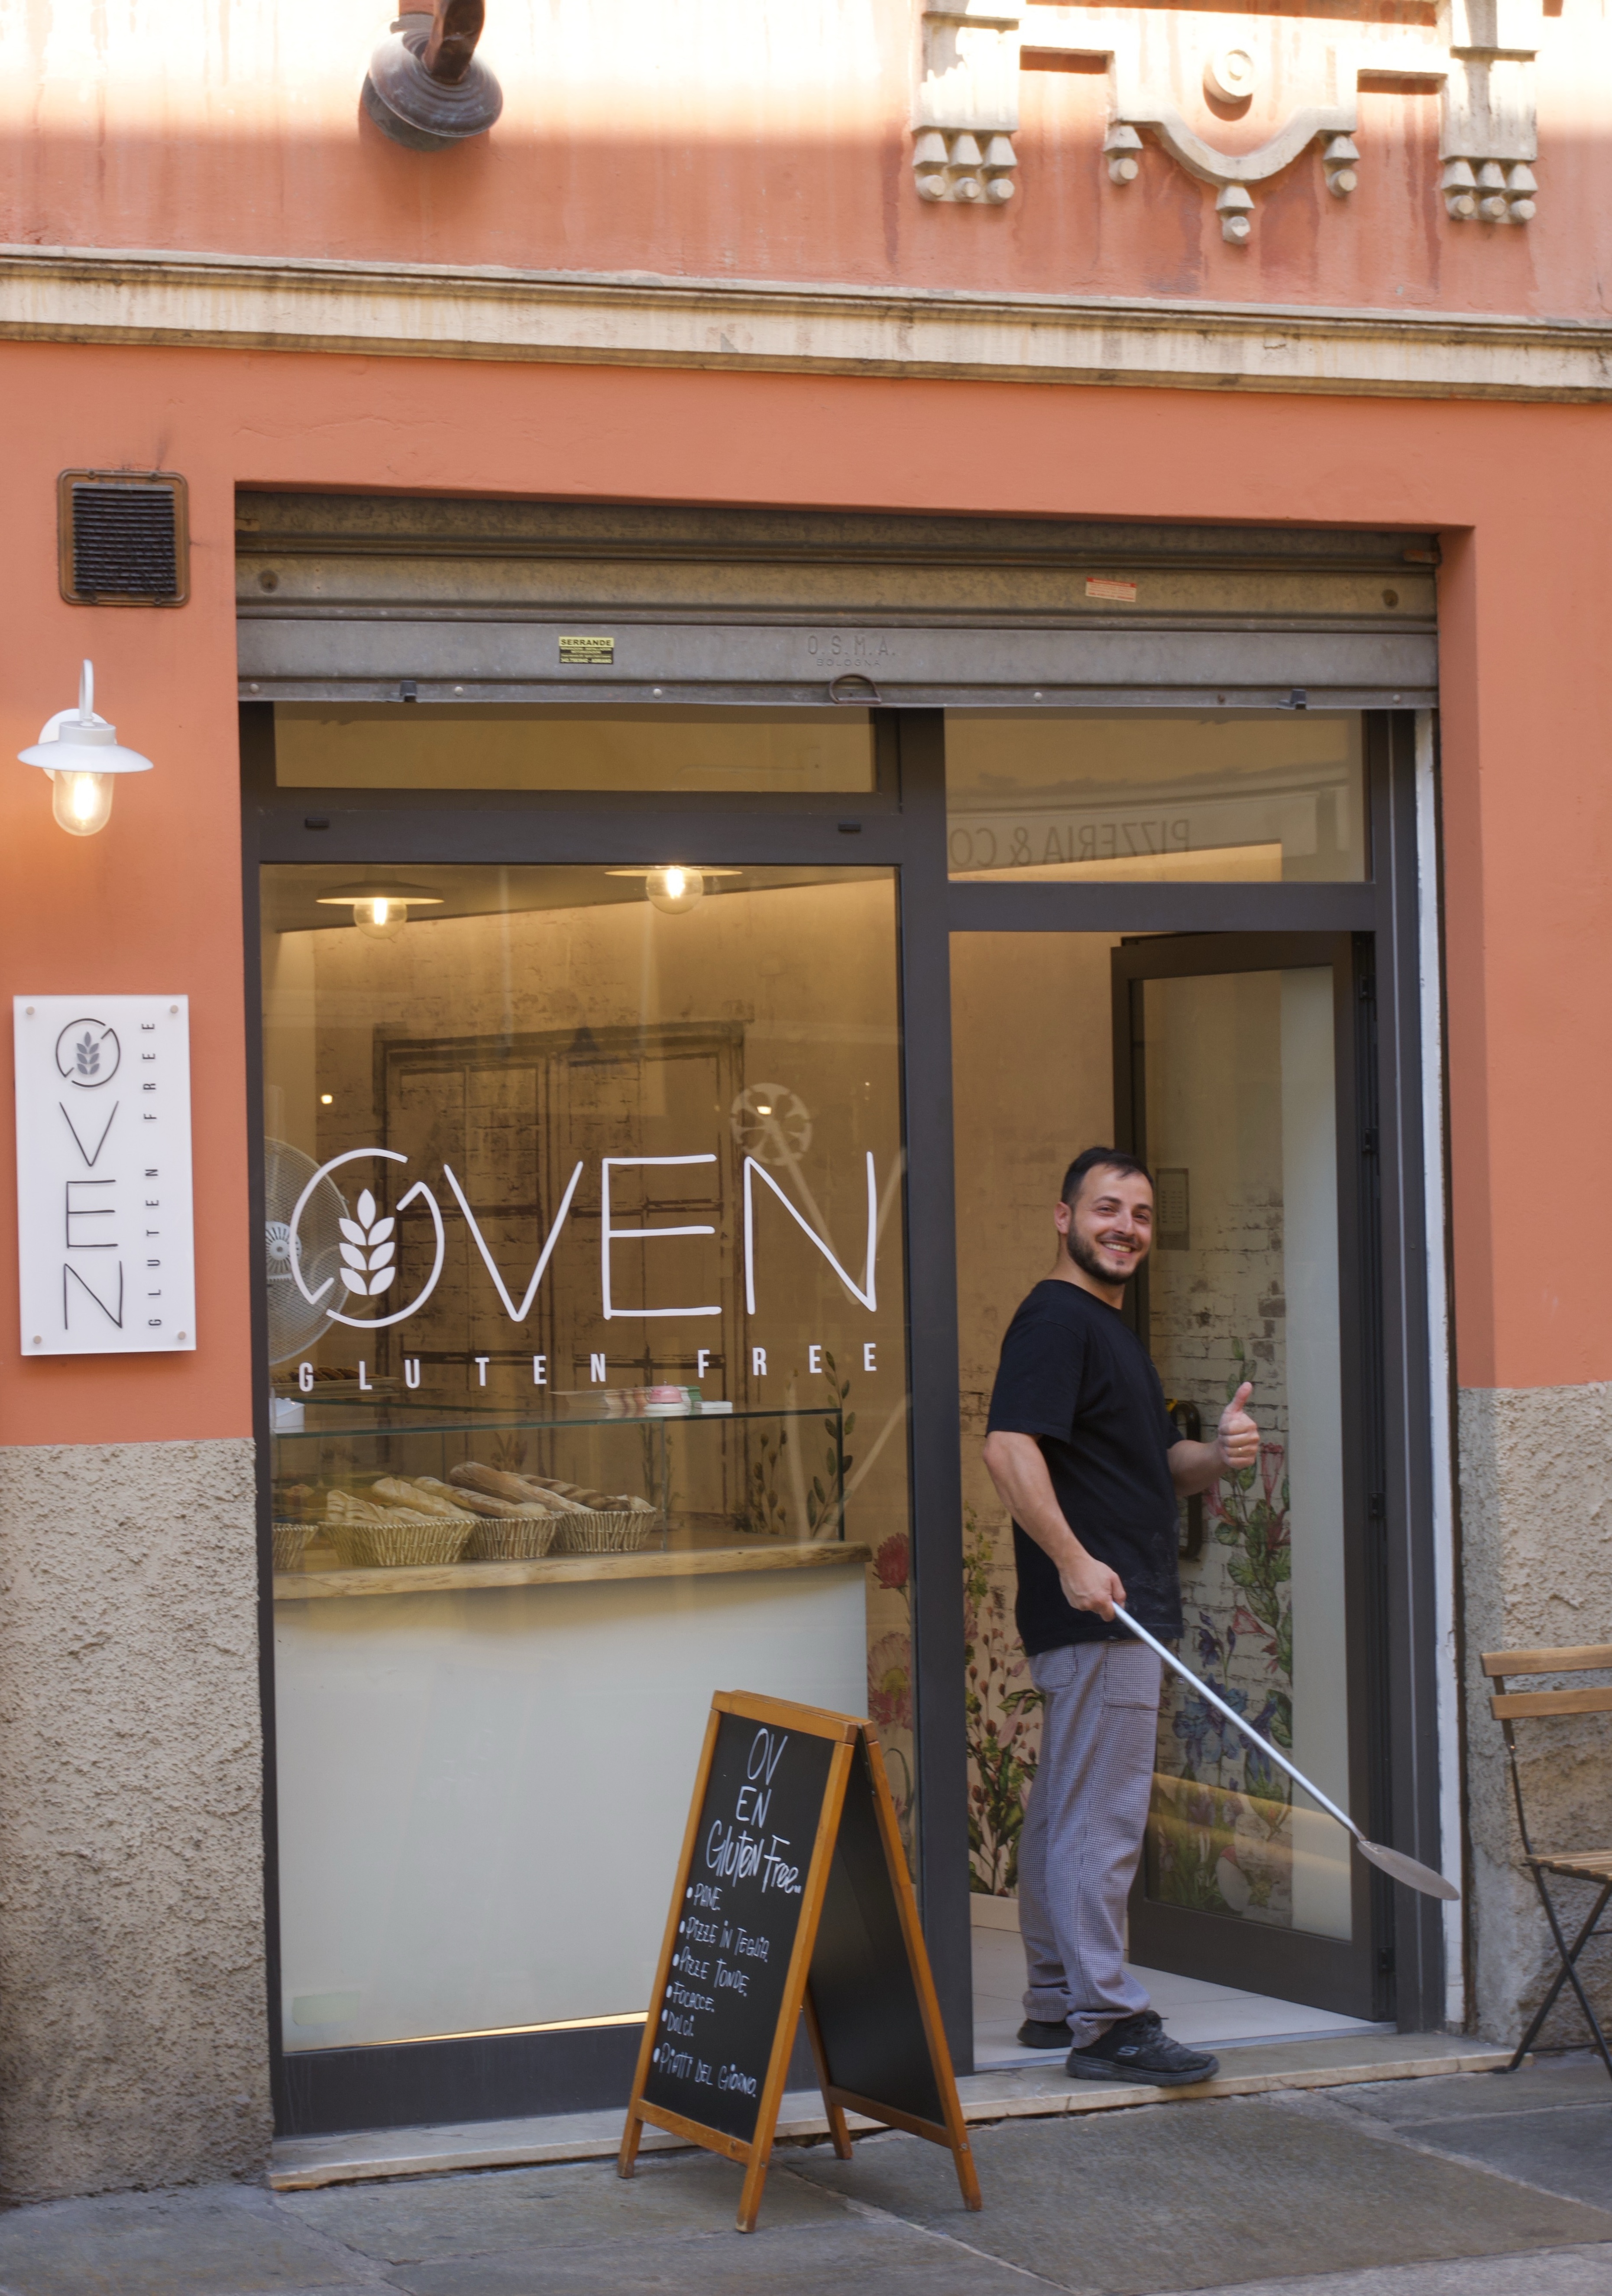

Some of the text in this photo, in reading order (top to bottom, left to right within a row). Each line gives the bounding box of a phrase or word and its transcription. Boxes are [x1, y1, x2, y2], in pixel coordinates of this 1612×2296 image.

[141, 1022, 162, 1326] GLUTEN FREE
[299, 1343, 877, 1392] GLUTEN FREE
[747, 1728, 788, 1785] OV
[736, 1786, 772, 1828] EN
